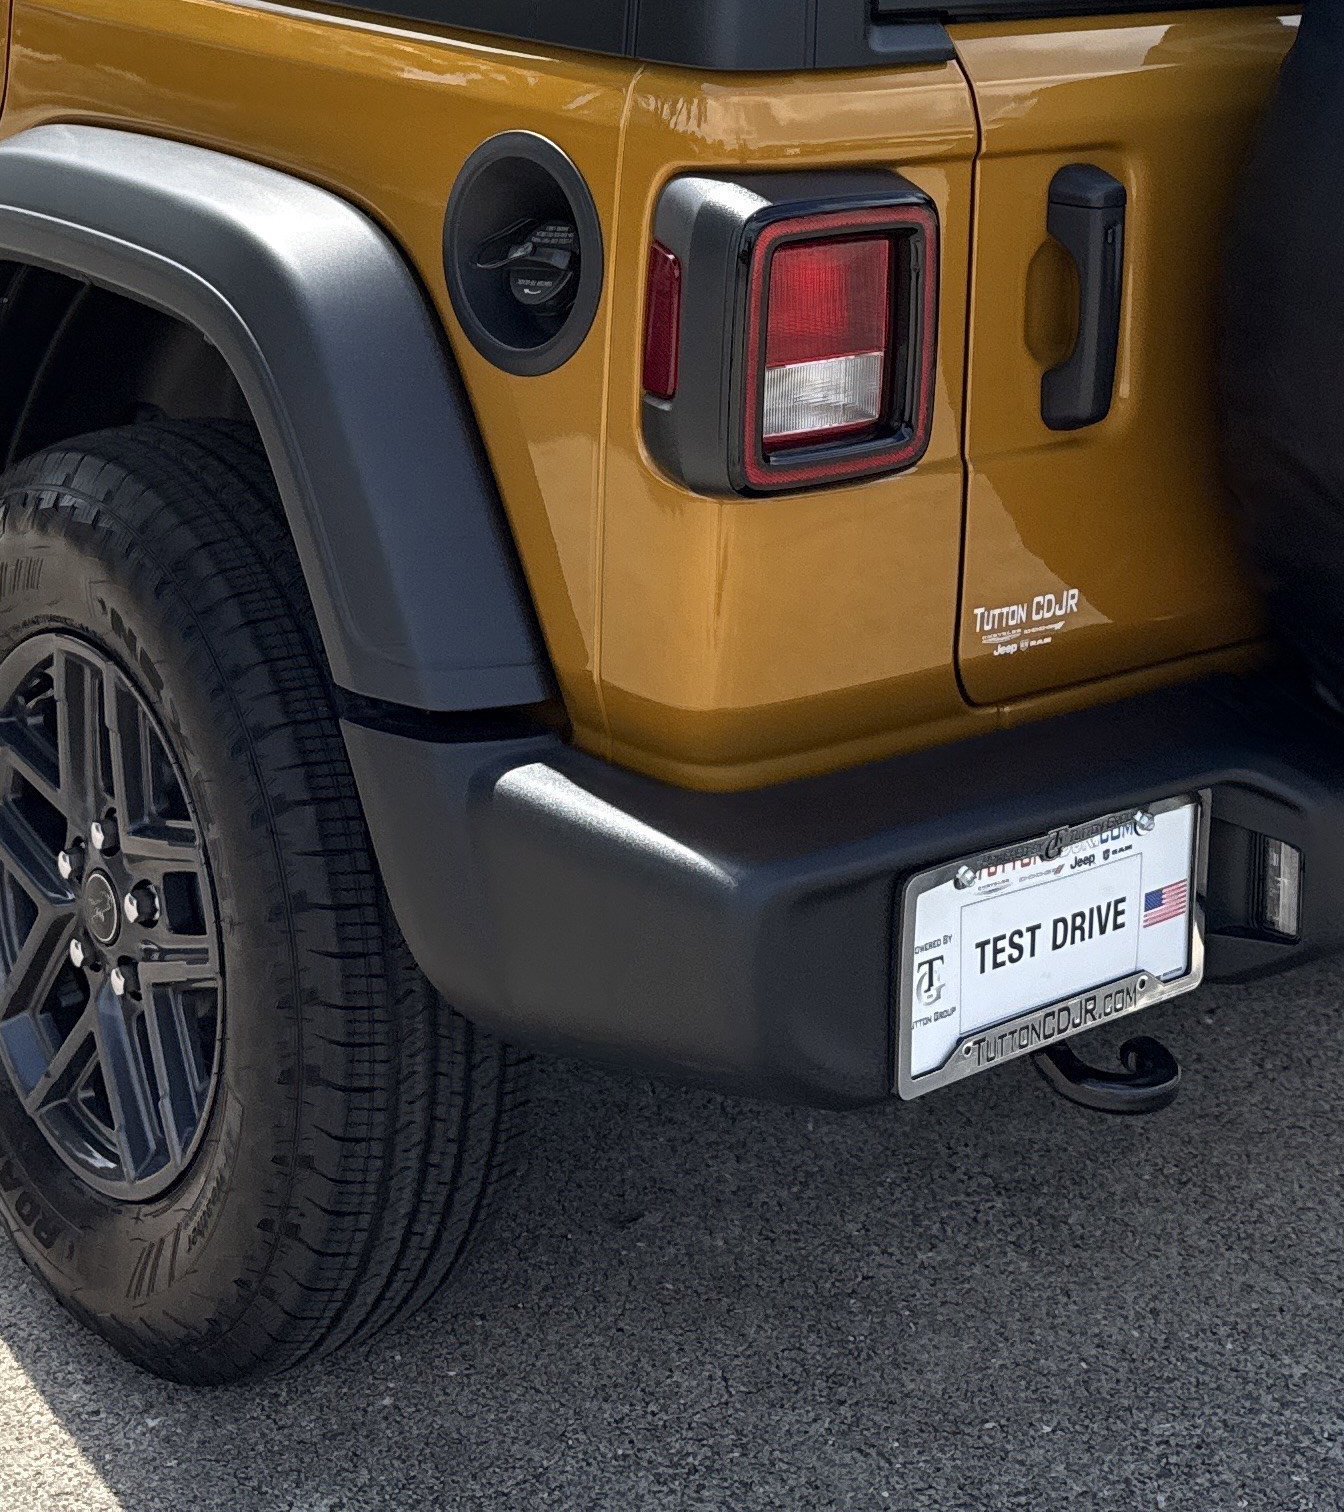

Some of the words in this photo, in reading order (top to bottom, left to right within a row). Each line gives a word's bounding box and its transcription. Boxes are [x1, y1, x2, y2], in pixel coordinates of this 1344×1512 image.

[1031, 588, 1079, 621] CDJR
[993, 643, 1017, 656] Jeep
[1070, 854, 1095, 869] Jeep
[975, 922, 1042, 975] TEST
[1051, 896, 1127, 952] DRIVE
[915, 938, 941, 955] OWERED
